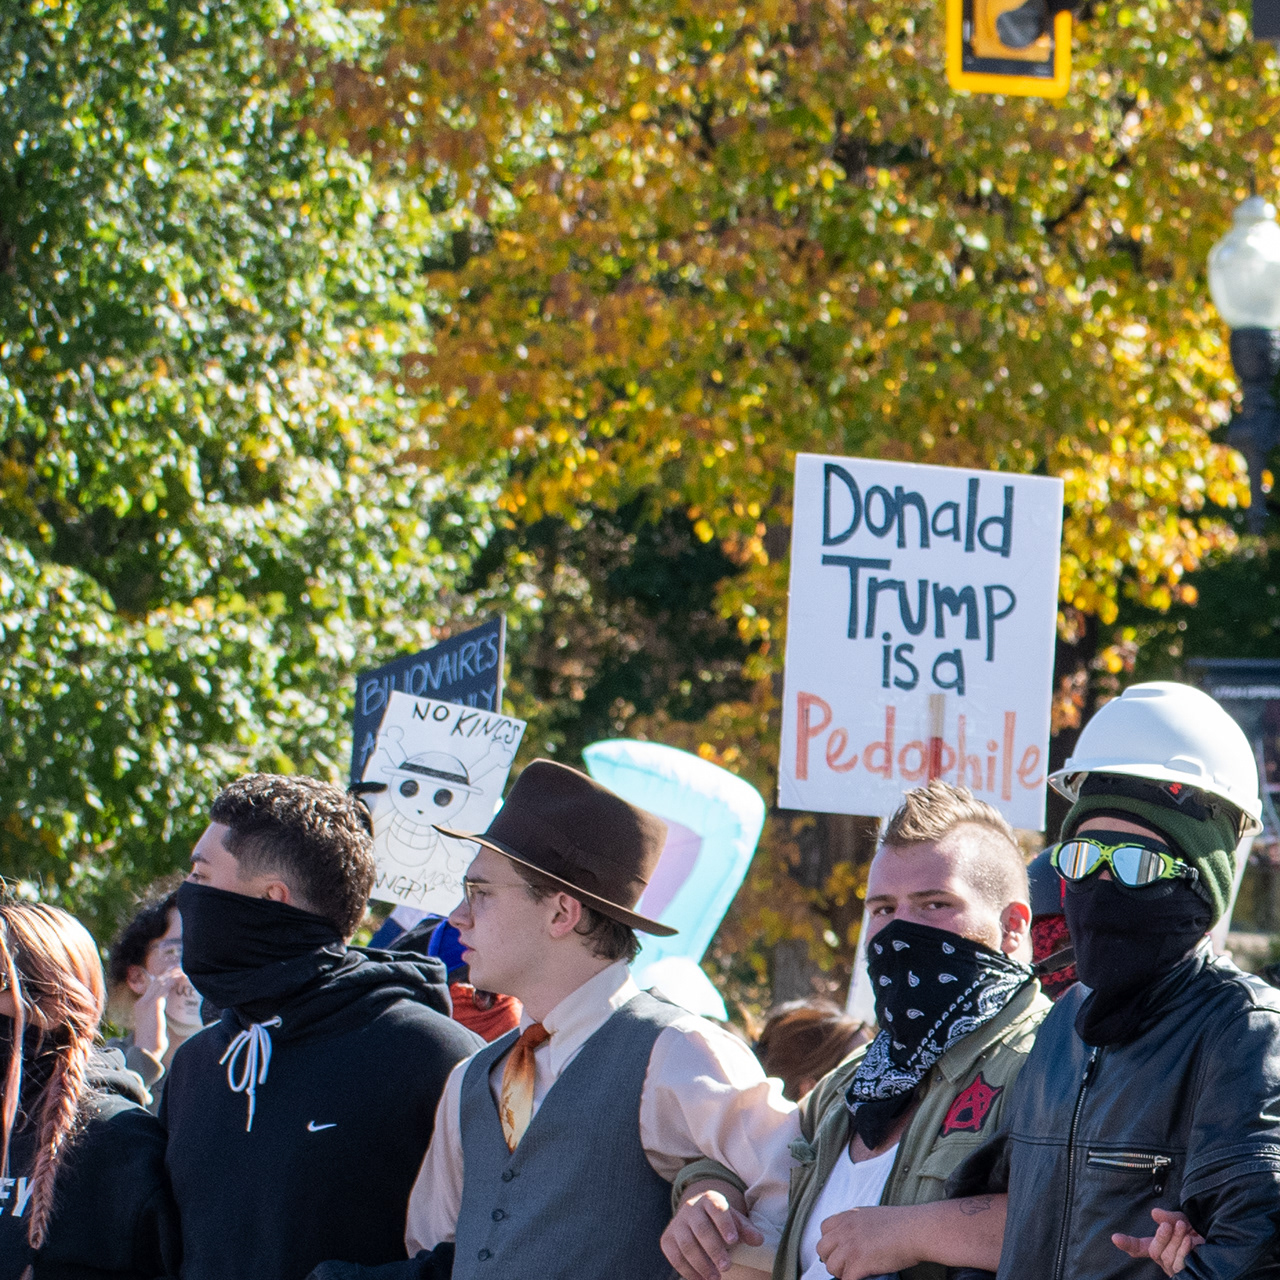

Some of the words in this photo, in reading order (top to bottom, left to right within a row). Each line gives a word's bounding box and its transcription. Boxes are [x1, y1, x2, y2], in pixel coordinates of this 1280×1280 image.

[822, 463, 1014, 557] Donald
[822, 554, 1017, 662] Trump
[881, 632, 920, 691] is
[931, 648, 965, 695] a
[412, 702, 450, 721] NO
[450, 709, 520, 744] KINGS
[795, 691, 1044, 801] Pedophile
[374, 872, 436, 904] NGRY
